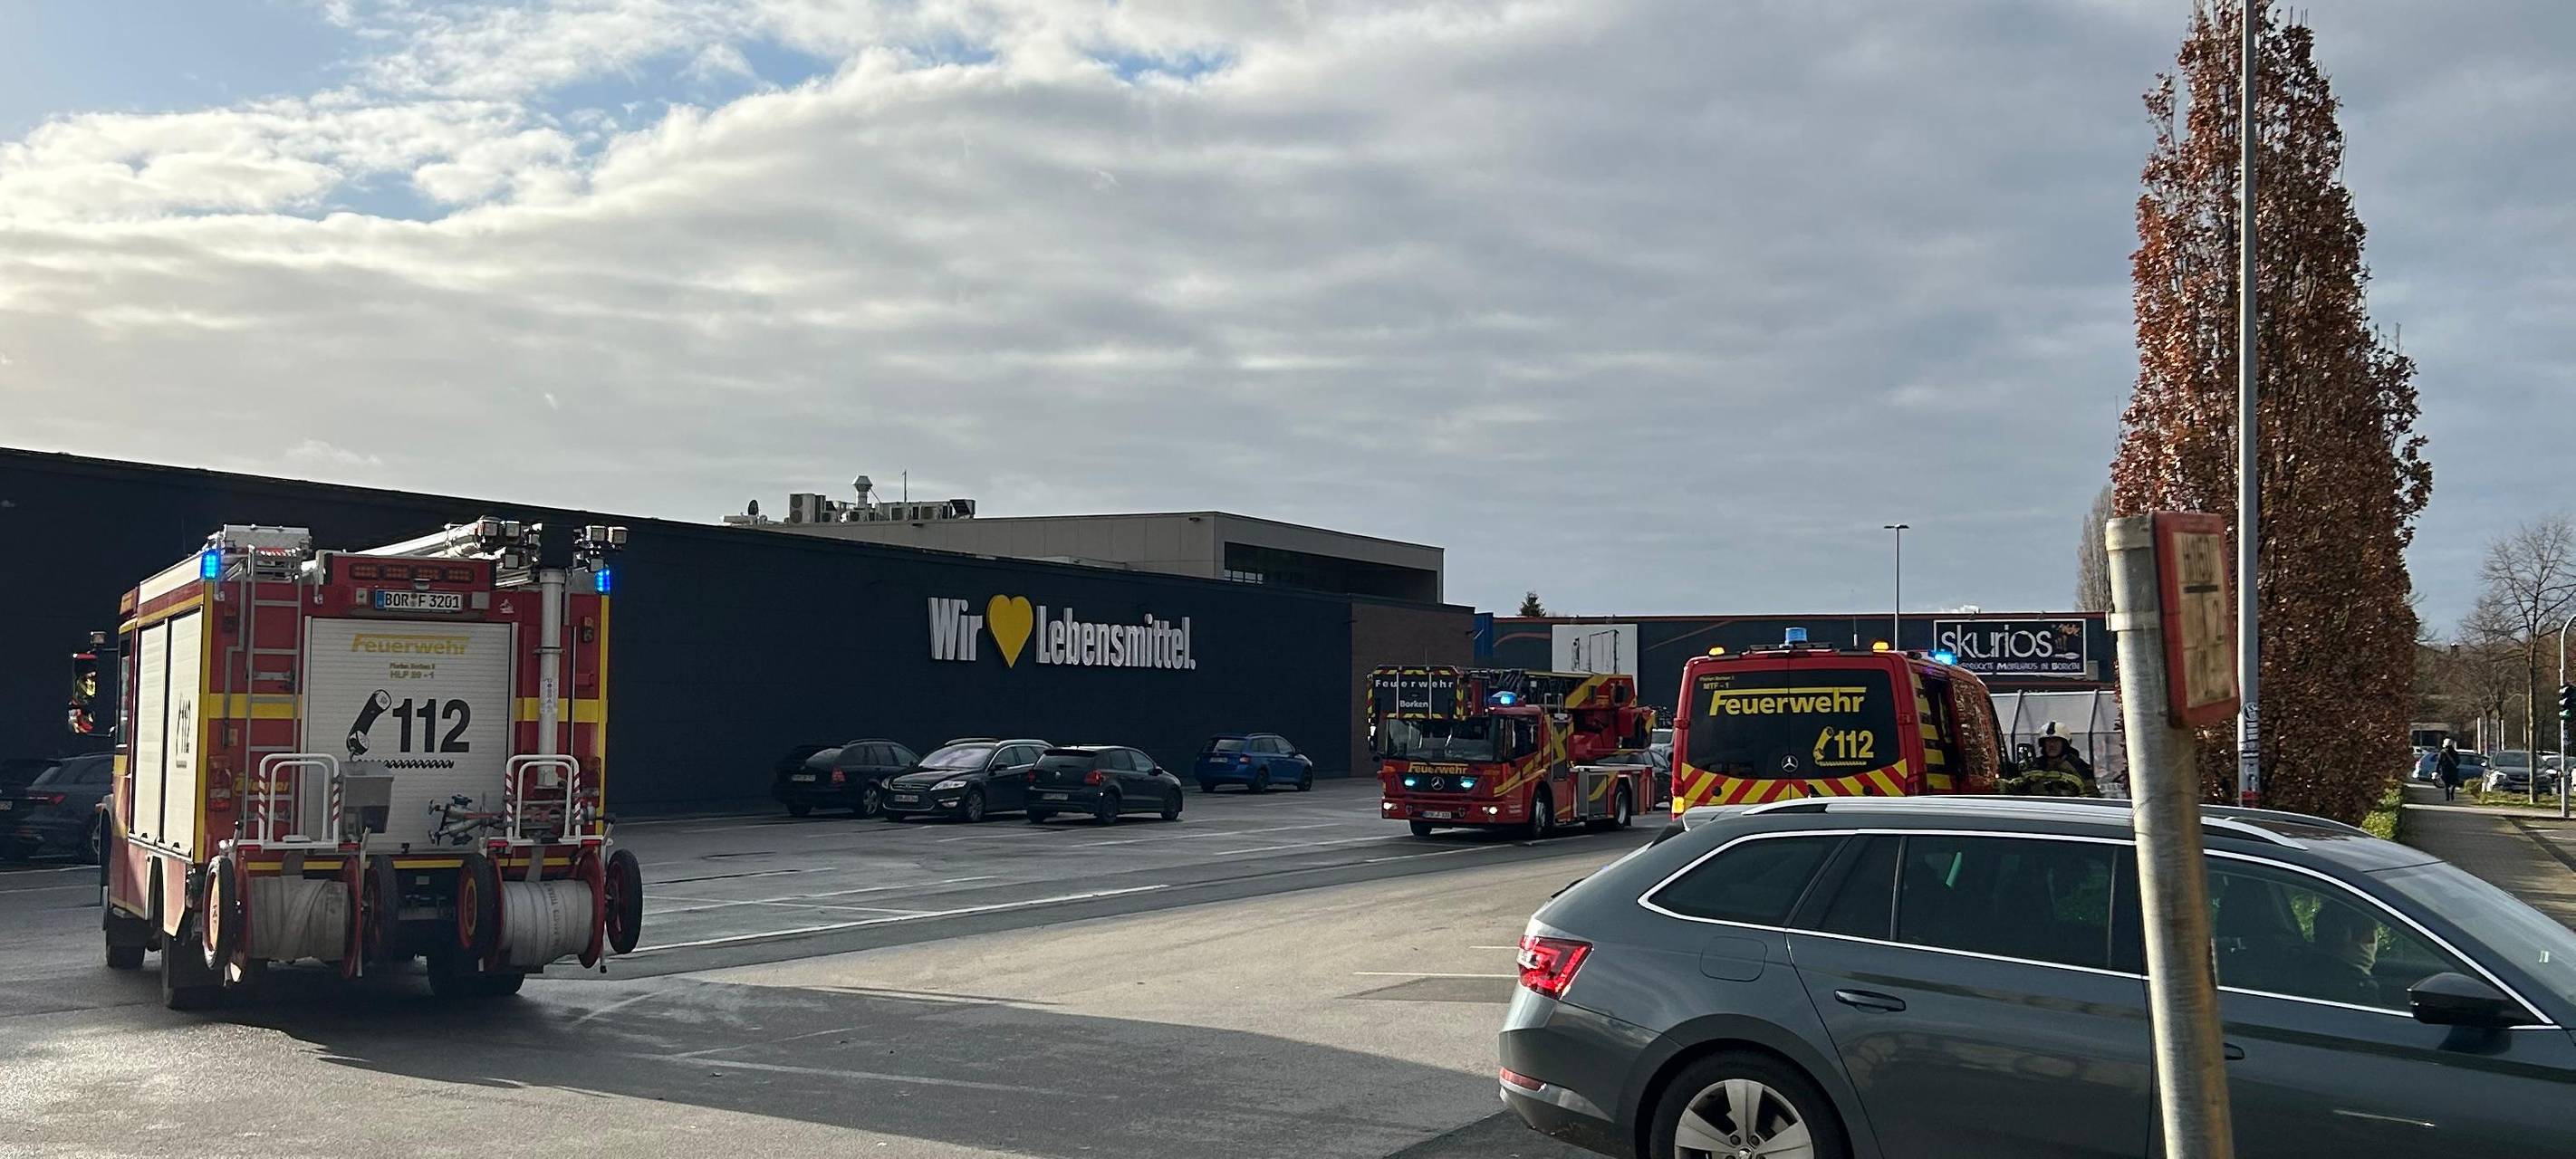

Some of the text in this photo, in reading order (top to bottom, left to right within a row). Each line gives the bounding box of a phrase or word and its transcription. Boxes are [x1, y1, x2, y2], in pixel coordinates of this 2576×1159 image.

[385, 593, 459, 608] BOR F 3201
[351, 633, 470, 655] Feuerwehr
[928, 597, 1197, 670] Wir Lebensmittel.
[1941, 624, 2053, 658] skurios
[1375, 679, 1453, 688] Feuerwehr
[1399, 700, 1428, 708] Borken
[1709, 686, 1867, 716] Feuerwehr
[392, 698, 471, 752] 112
[1834, 730, 1874, 759] 112
[1408, 762, 1469, 774] Feuerwehr
